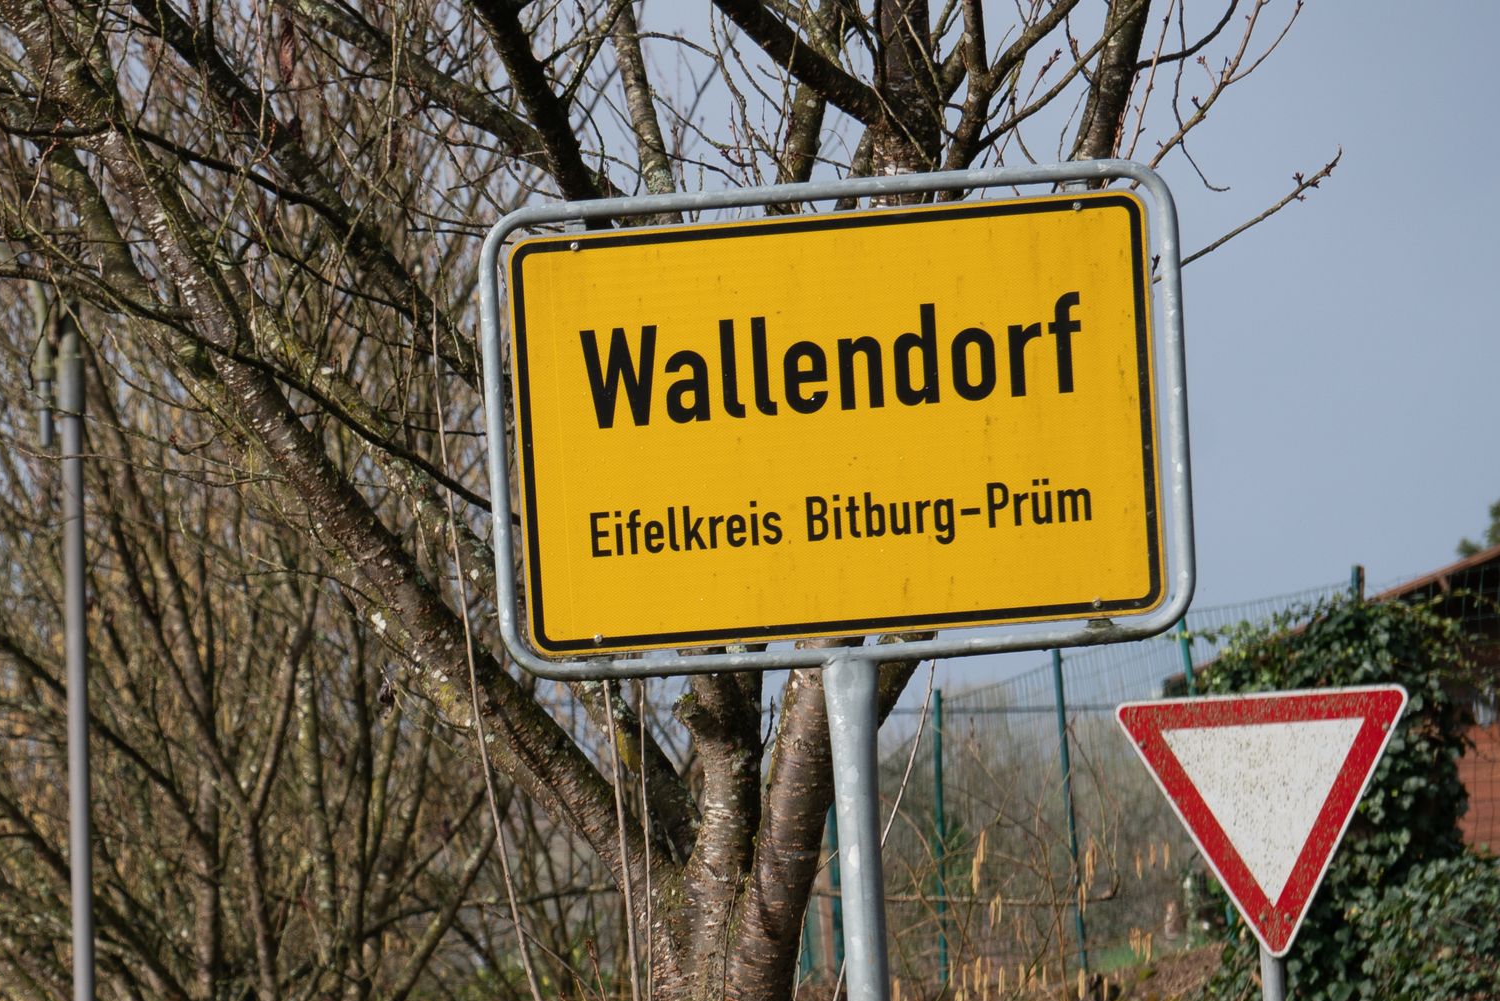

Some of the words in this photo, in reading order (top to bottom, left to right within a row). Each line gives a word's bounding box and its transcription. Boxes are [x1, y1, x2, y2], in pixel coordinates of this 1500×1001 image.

[580, 291, 1082, 429] Wallendorf
[589, 500, 783, 557] Eifelkreis
[805, 478, 1092, 544] Bitburg-Prüm
